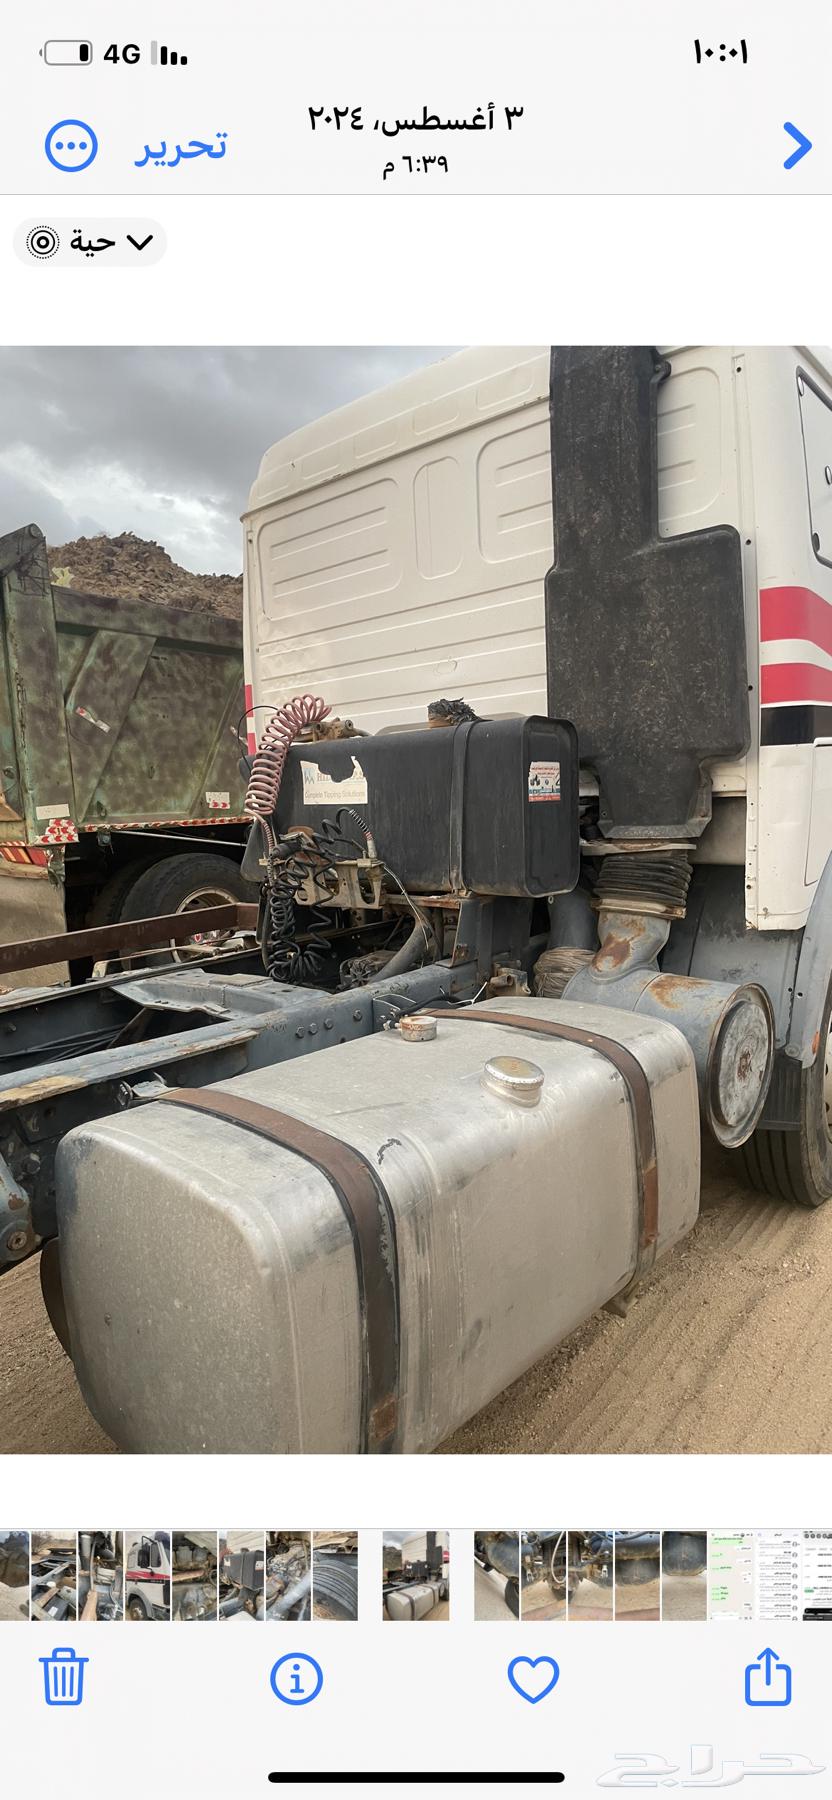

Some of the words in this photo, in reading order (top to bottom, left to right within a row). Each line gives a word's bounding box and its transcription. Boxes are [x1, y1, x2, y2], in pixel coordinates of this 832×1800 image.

[103, 43, 141, 65] 4G
[693, 39, 748, 65] ١٠:٠١
[307, 106, 364, 131] ٢٠٢٤
[373, 102, 496, 138] أغسطس،
[504, 106, 524, 131] ٣
[133, 132, 229, 168] تحرير
[382, 161, 395, 181] م
[401, 155, 449, 174] ٦:٣٩
[69, 229, 116, 254] حية
